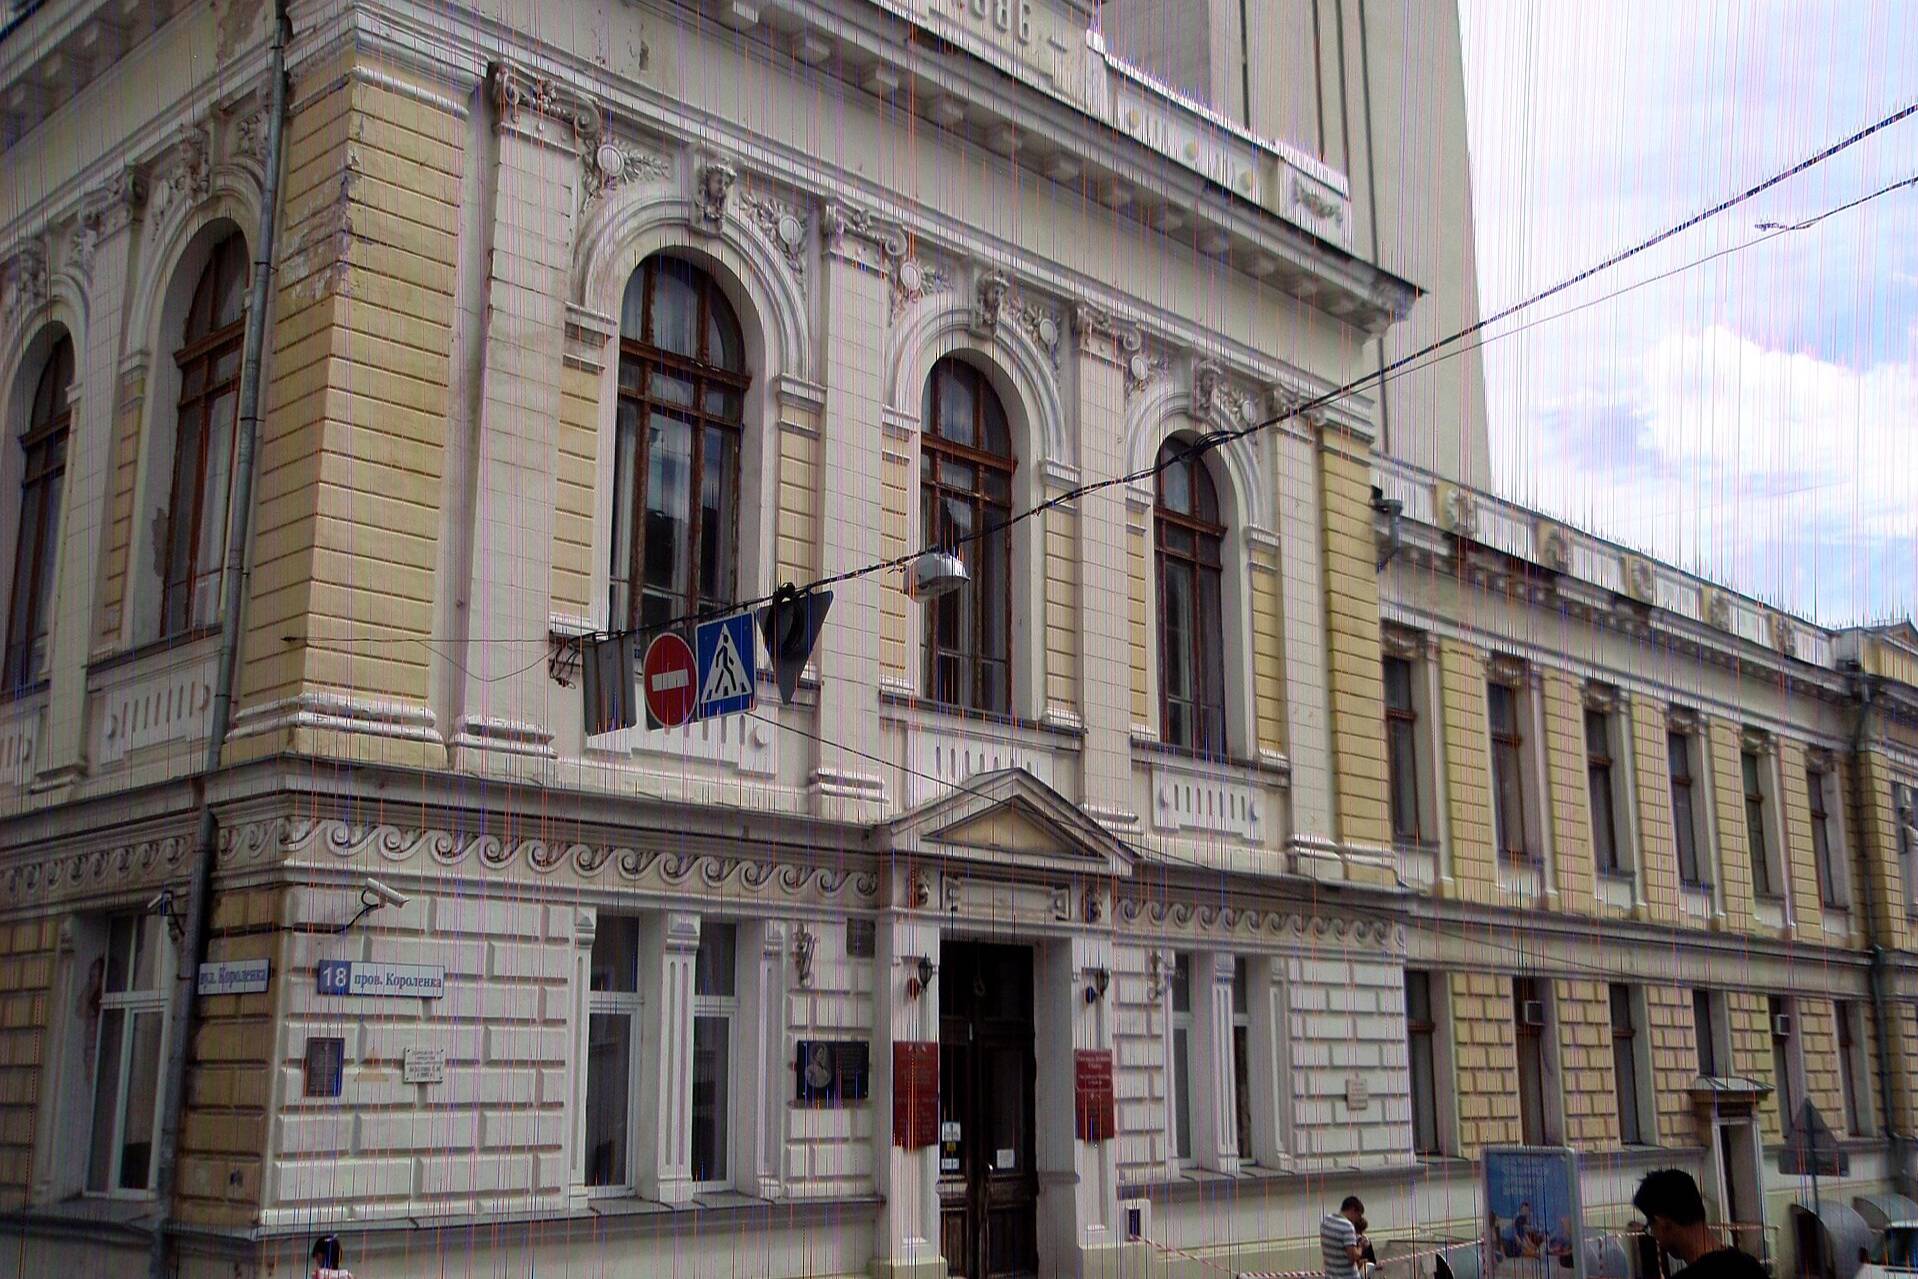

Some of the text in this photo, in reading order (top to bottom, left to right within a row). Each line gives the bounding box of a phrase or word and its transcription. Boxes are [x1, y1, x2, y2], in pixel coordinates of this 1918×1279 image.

[218, 967, 266, 988] Короленка
[323, 966, 442, 990] 18 пров. Короленка
